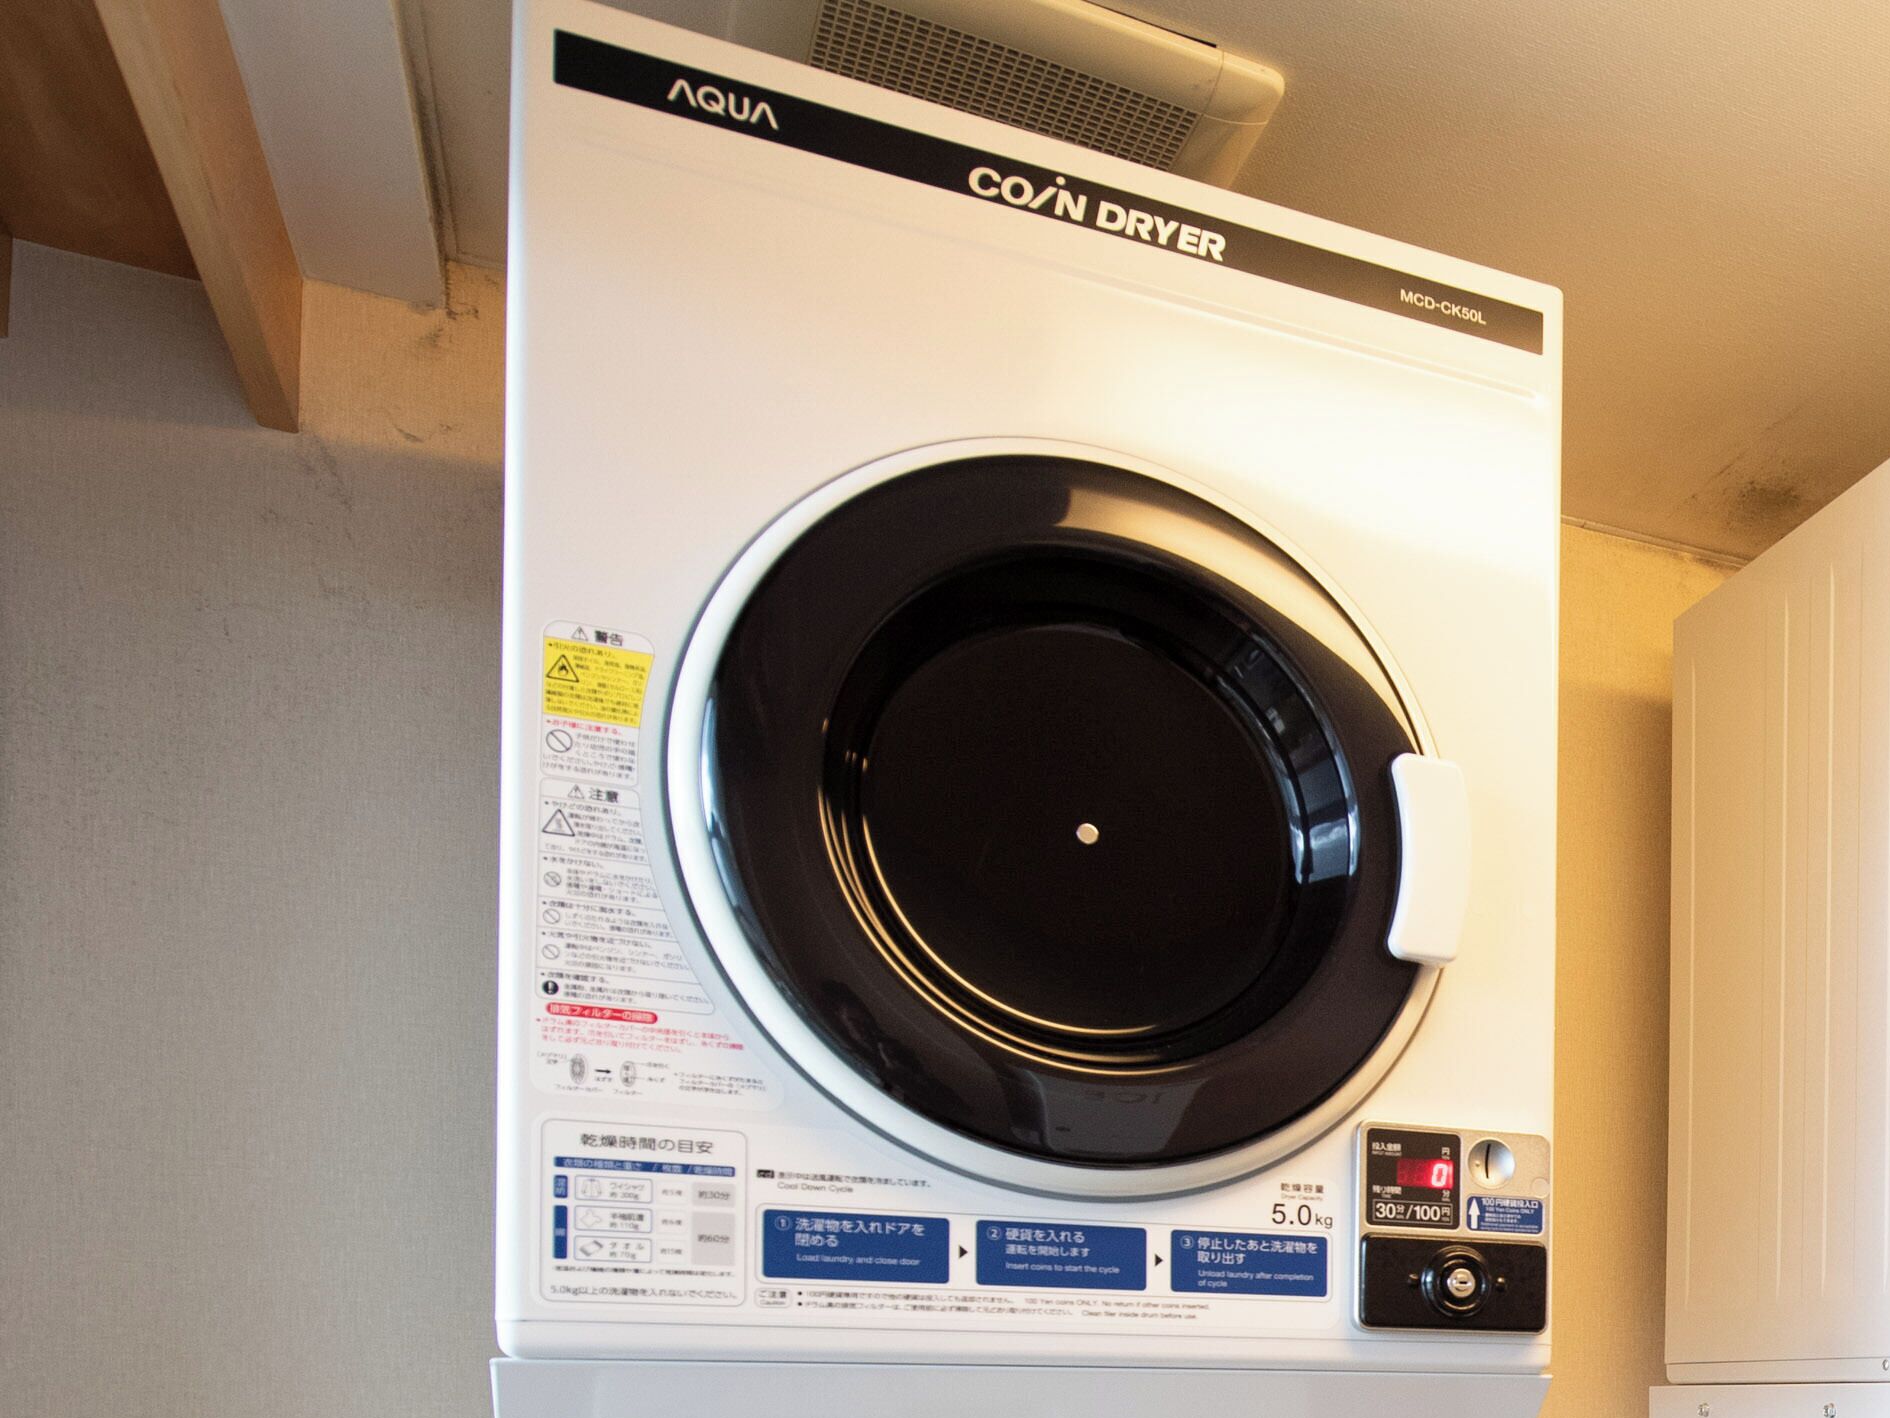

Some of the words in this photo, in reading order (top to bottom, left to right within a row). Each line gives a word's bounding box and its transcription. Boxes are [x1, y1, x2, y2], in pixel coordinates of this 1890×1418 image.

[667, 78, 778, 129] AQUA
[1096, 203, 1225, 262] DRYER
[1400, 288, 1487, 326] MCD-CK50L
[589, 787, 618, 803] 注意
[581, 1133, 713, 1153] 乾燥時間の目安
[1431, 1163, 1448, 1187] 0
[795, 1217, 926, 1237] 洗濯物を入れドアを
[1005, 1227, 1085, 1244] 硬貨を入れる
[795, 1234, 839, 1247] 閉める
[1197, 1237, 1318, 1254] 停止したあと洗濯物を
[796, 1253, 819, 1262] Load
[1197, 1251, 1246, 1265] 取り出す
